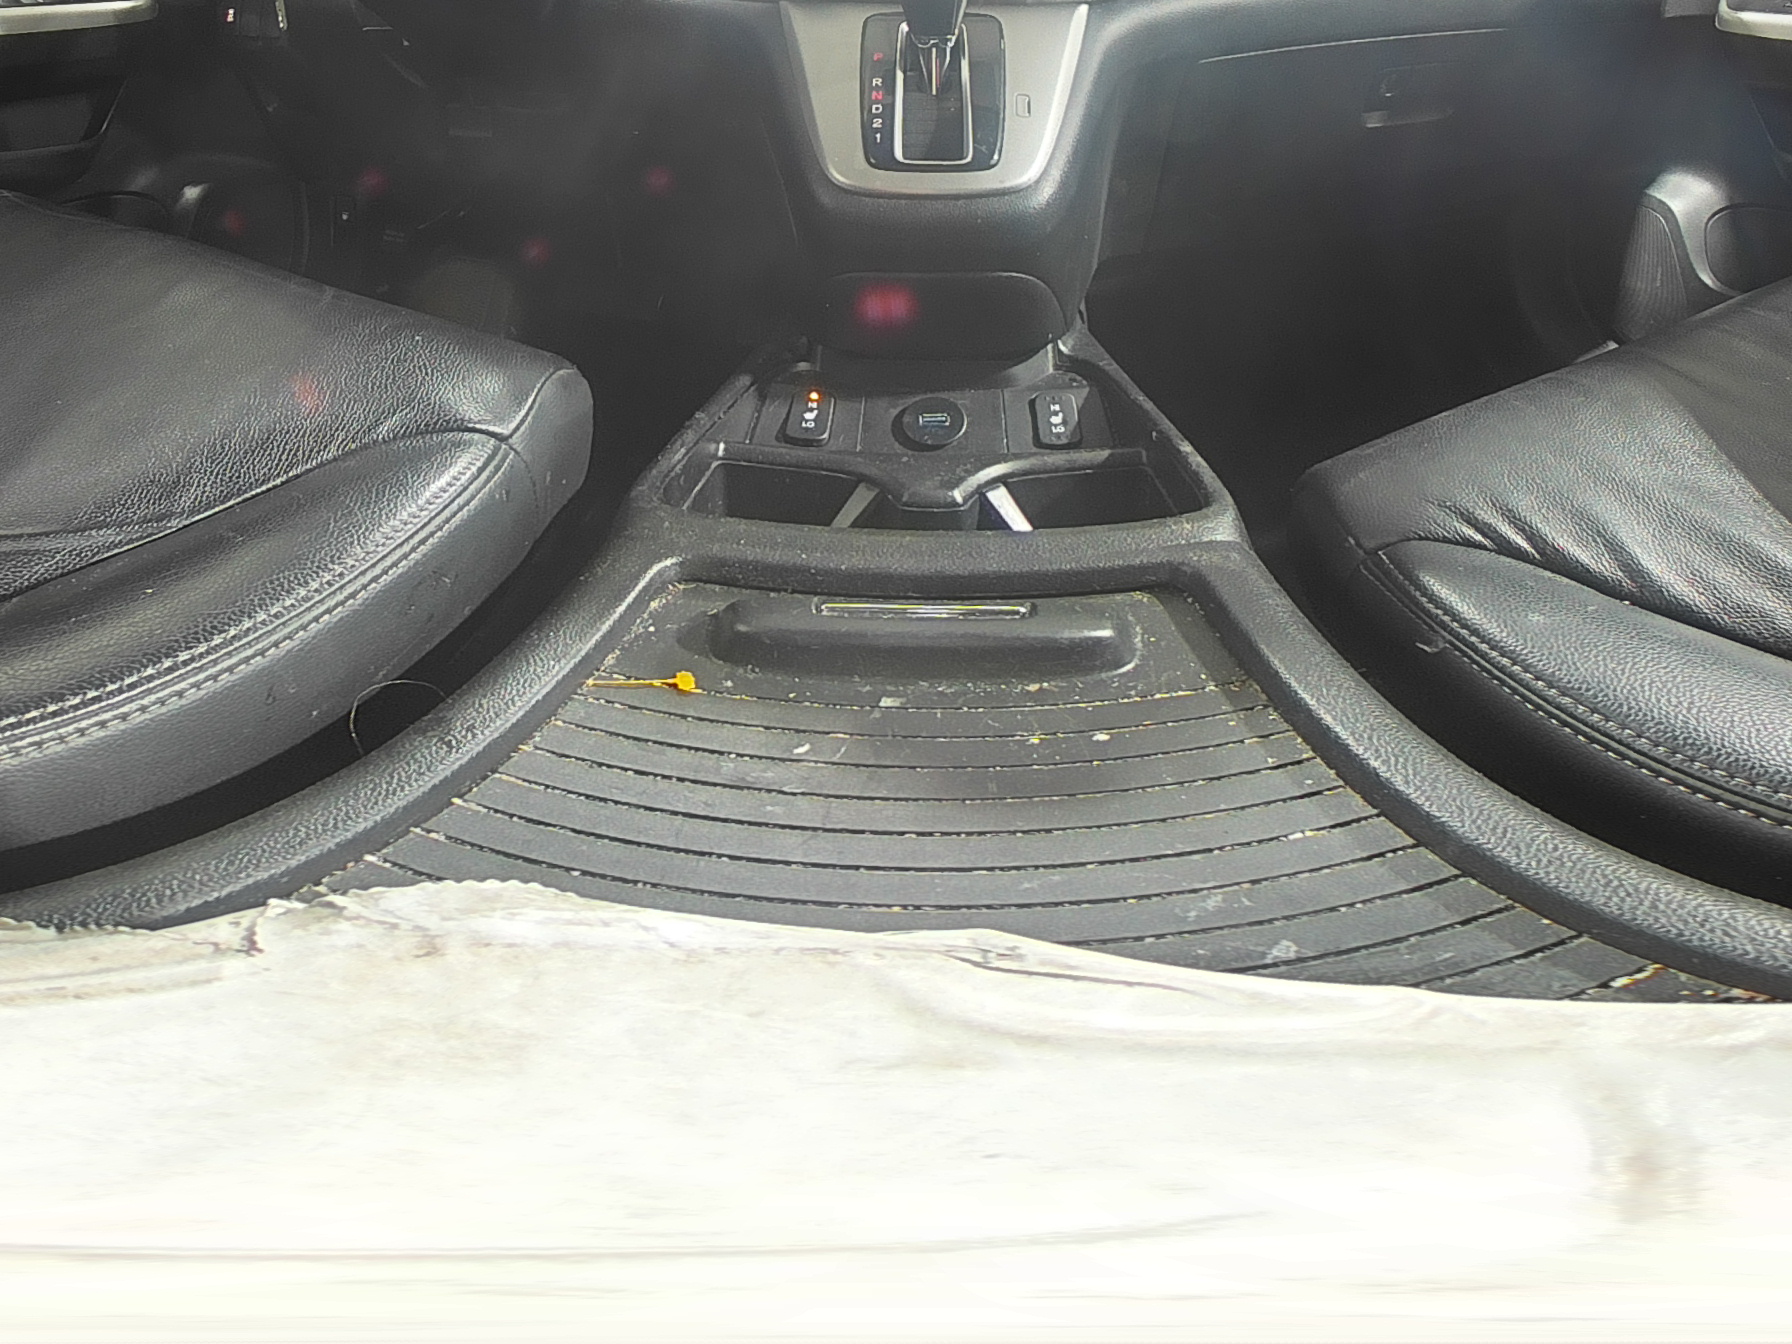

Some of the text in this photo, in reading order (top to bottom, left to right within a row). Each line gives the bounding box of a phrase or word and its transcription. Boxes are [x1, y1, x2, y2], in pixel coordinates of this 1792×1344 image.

[873, 52, 884, 62] P
[872, 77, 883, 87] R
[871, 90, 884, 101] N
[871, 104, 883, 114] D
[871, 118, 883, 128] 2
[874, 132, 881, 143] 1
[801, 420, 816, 428] LO
[1050, 424, 1066, 434] LO
